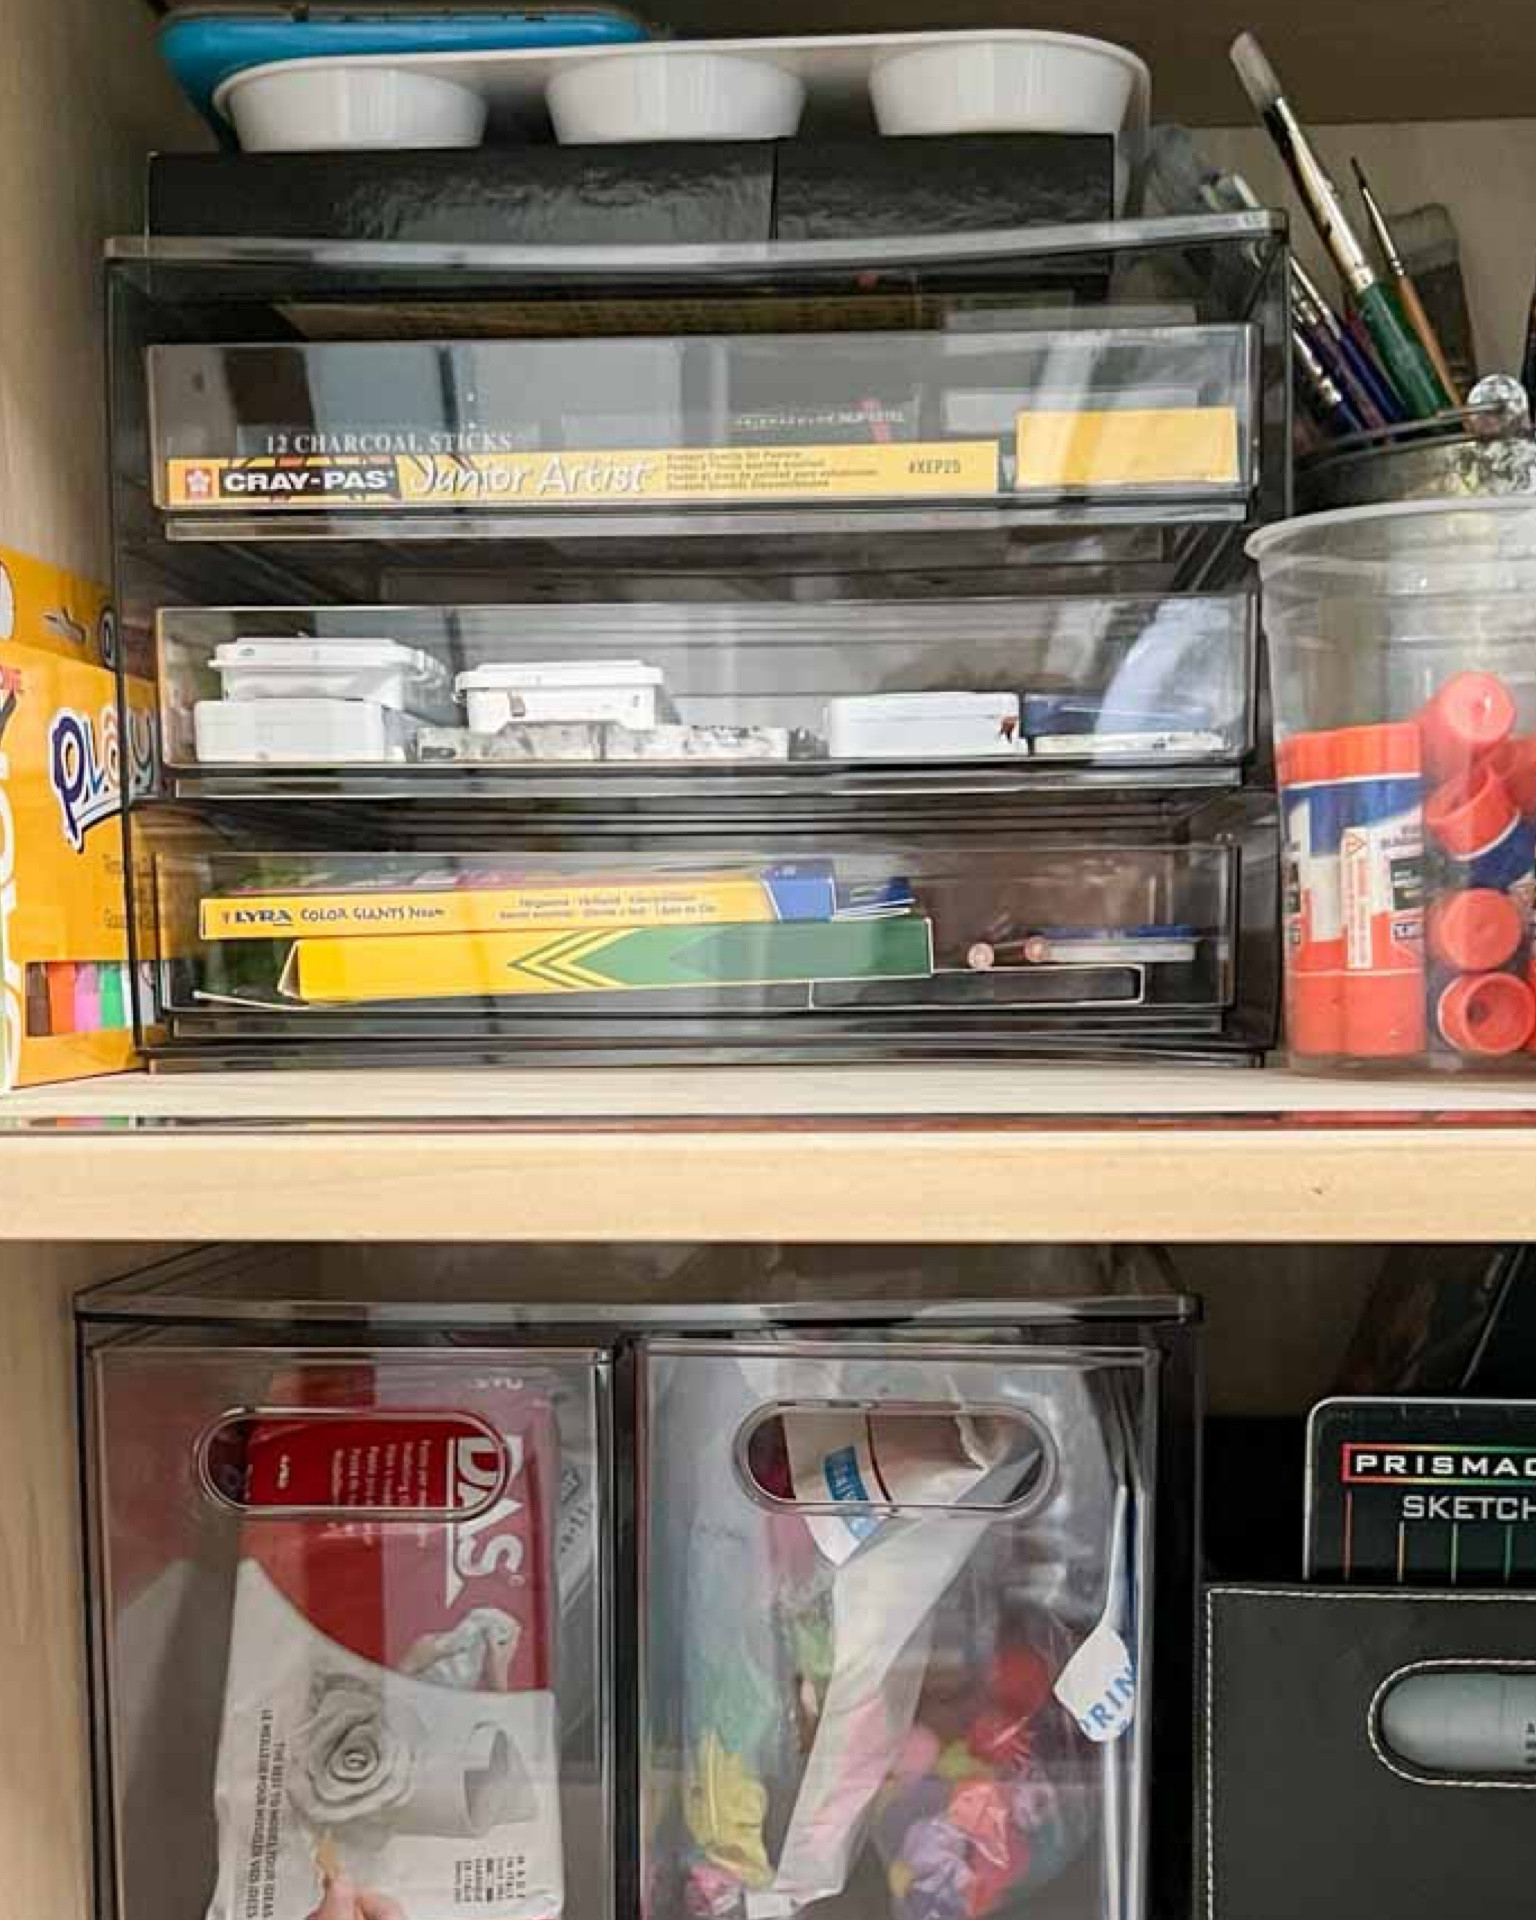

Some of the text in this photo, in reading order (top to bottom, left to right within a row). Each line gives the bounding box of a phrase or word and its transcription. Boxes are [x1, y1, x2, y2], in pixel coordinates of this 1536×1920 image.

[267, 430, 511, 454] 12 CHARCOAL STICKS
[410, 456, 531, 494] Junior
[537, 454, 651, 494] Artist
[234, 909, 293, 924] LYRA
[300, 908, 347, 922] COLOR
[353, 906, 404, 920] GIANTS
[456, 1434, 524, 1578] DAS
